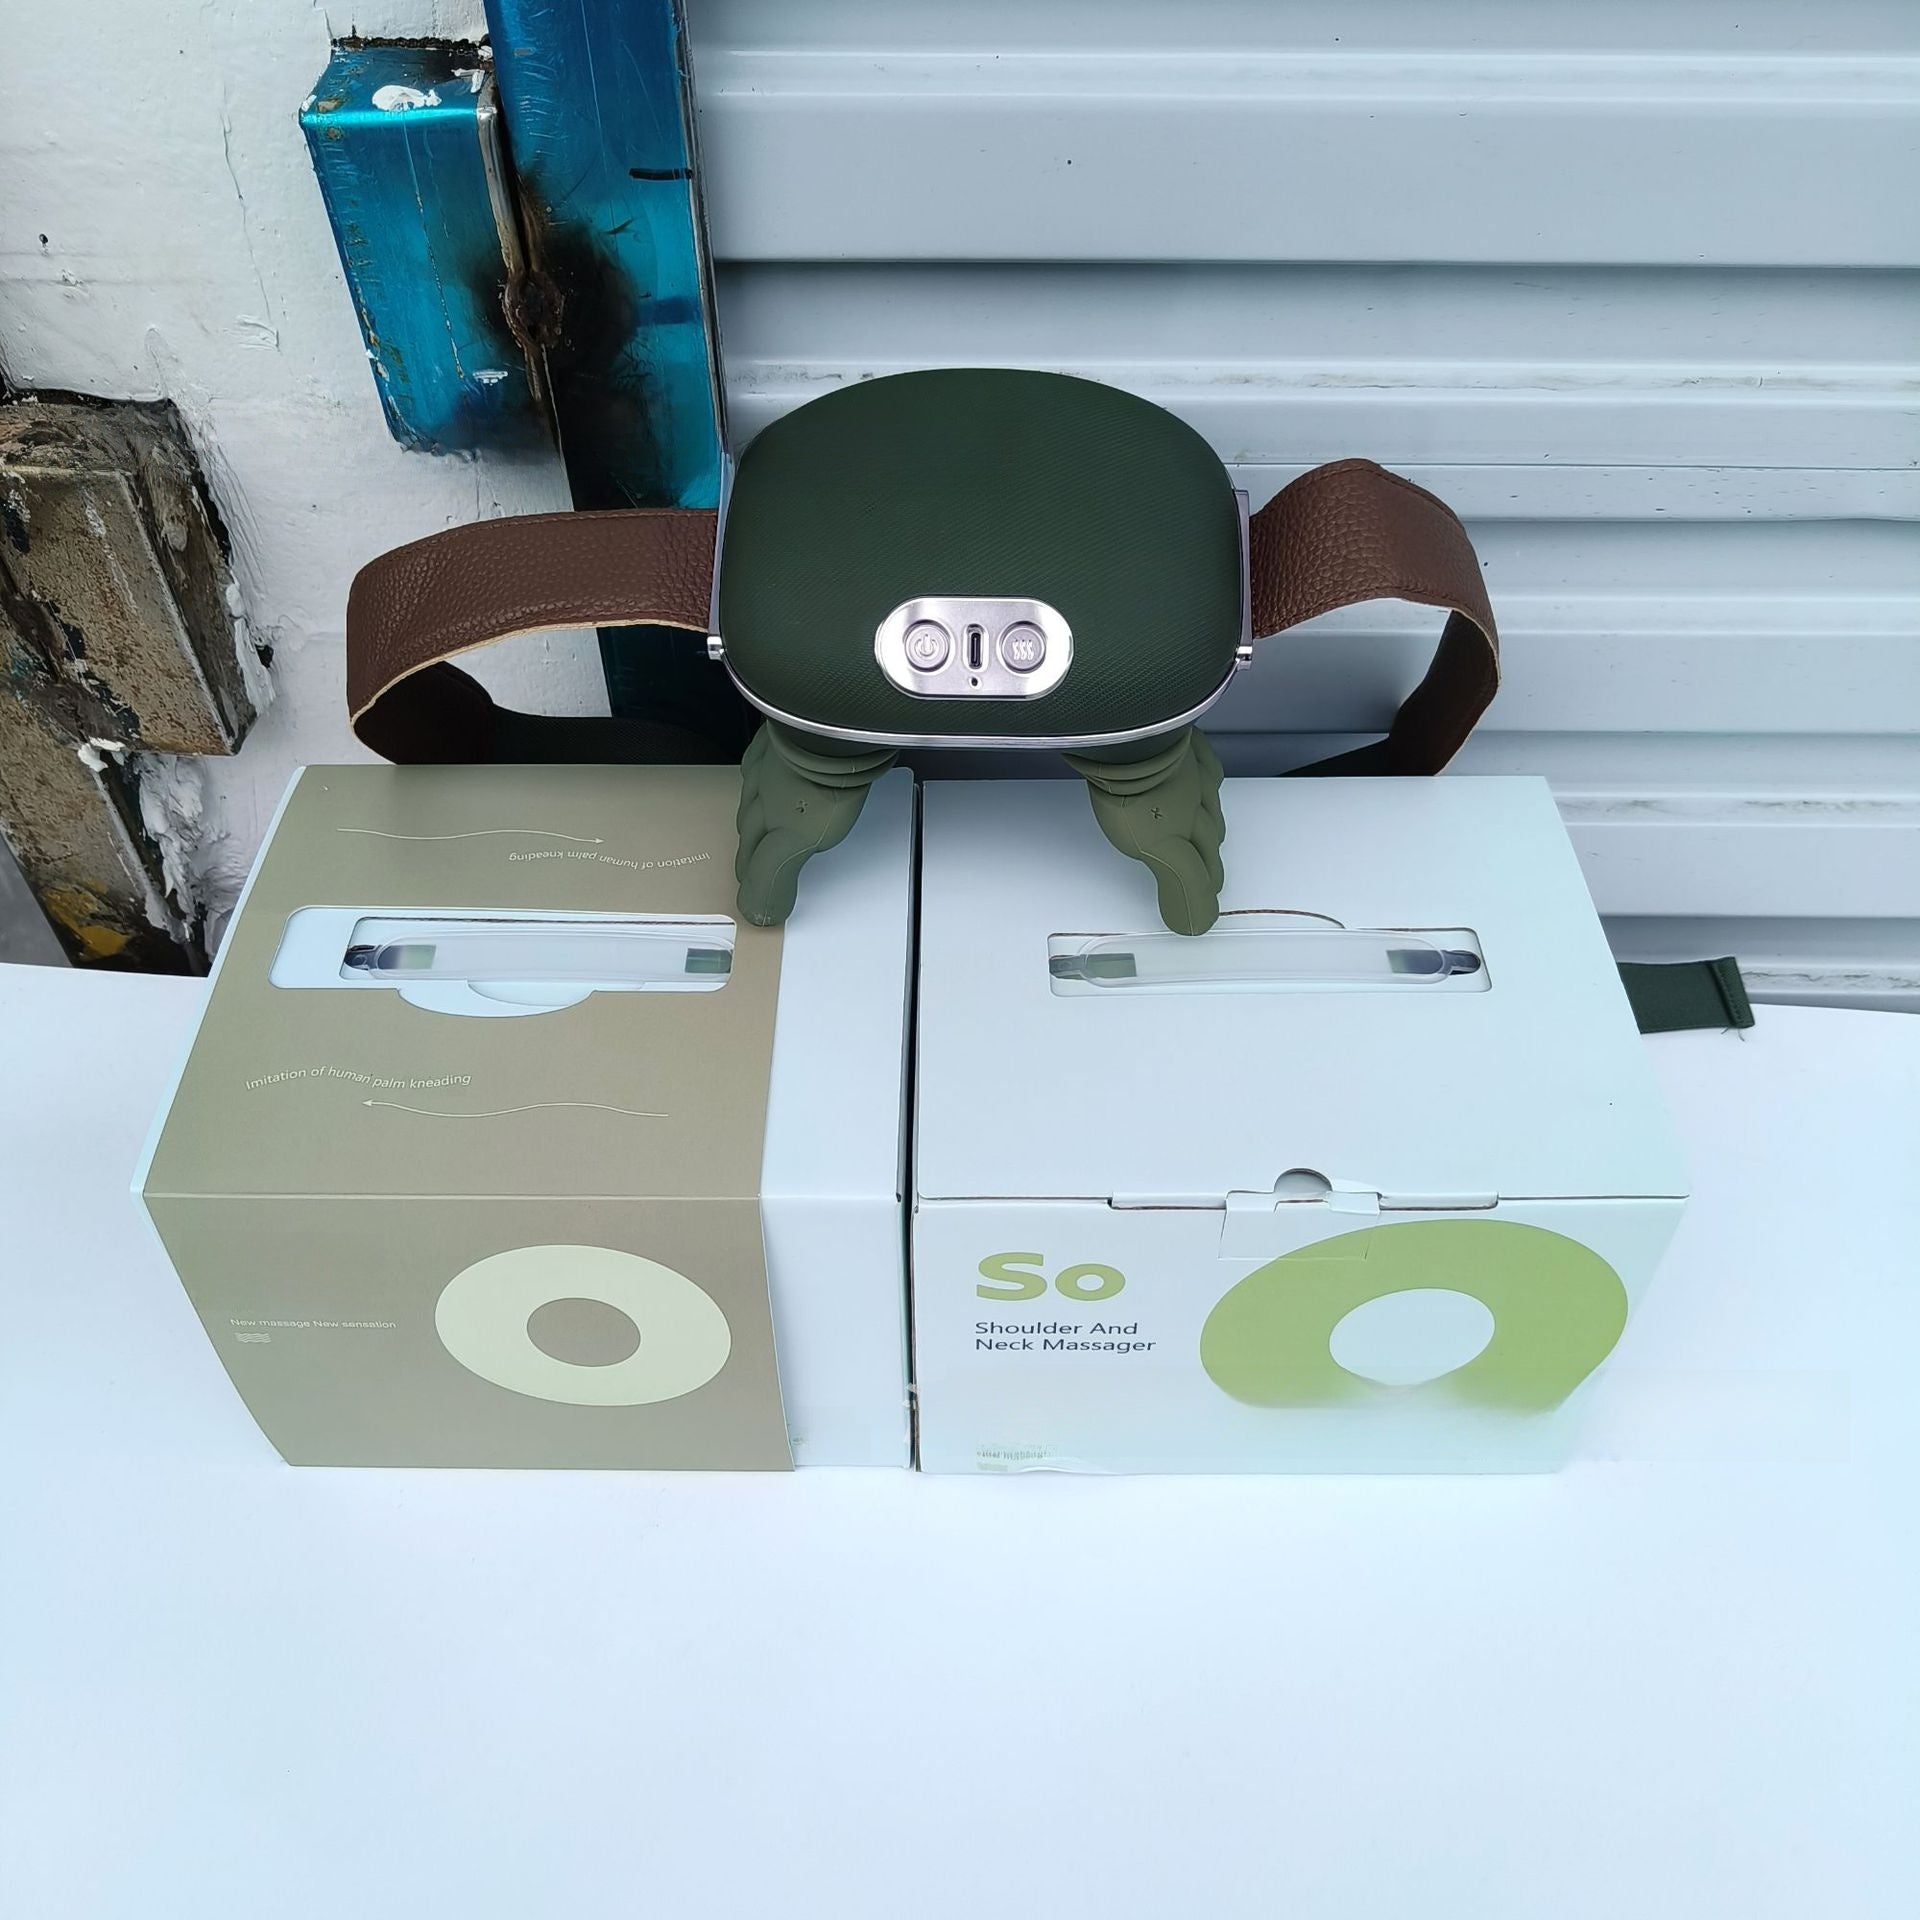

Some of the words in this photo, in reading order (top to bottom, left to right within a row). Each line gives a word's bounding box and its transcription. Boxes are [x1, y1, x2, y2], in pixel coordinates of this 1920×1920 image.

[509, 850, 564, 863] kneading
[567, 850, 598, 861] palm
[598, 854, 639, 871] human
[657, 852, 711, 869] Imitation
[640, 861, 654, 870] of
[245, 1068, 306, 1090] Imitation
[310, 1065, 327, 1077] of
[328, 1066, 371, 1084] human
[371, 1077, 405, 1089] palm
[409, 1074, 472, 1089] kneading
[976, 1251, 1126, 1301] So
[230, 1318, 256, 1327] New
[259, 1319, 311, 1329] massage
[312, 1319, 339, 1328] New
[341, 1319, 397, 1329] sensation
[975, 1321, 1083, 1335] Shoulder
[1089, 1321, 1139, 1335] And
[975, 1338, 1035, 1351] Neck
[1042, 1338, 1157, 1354] Massager
